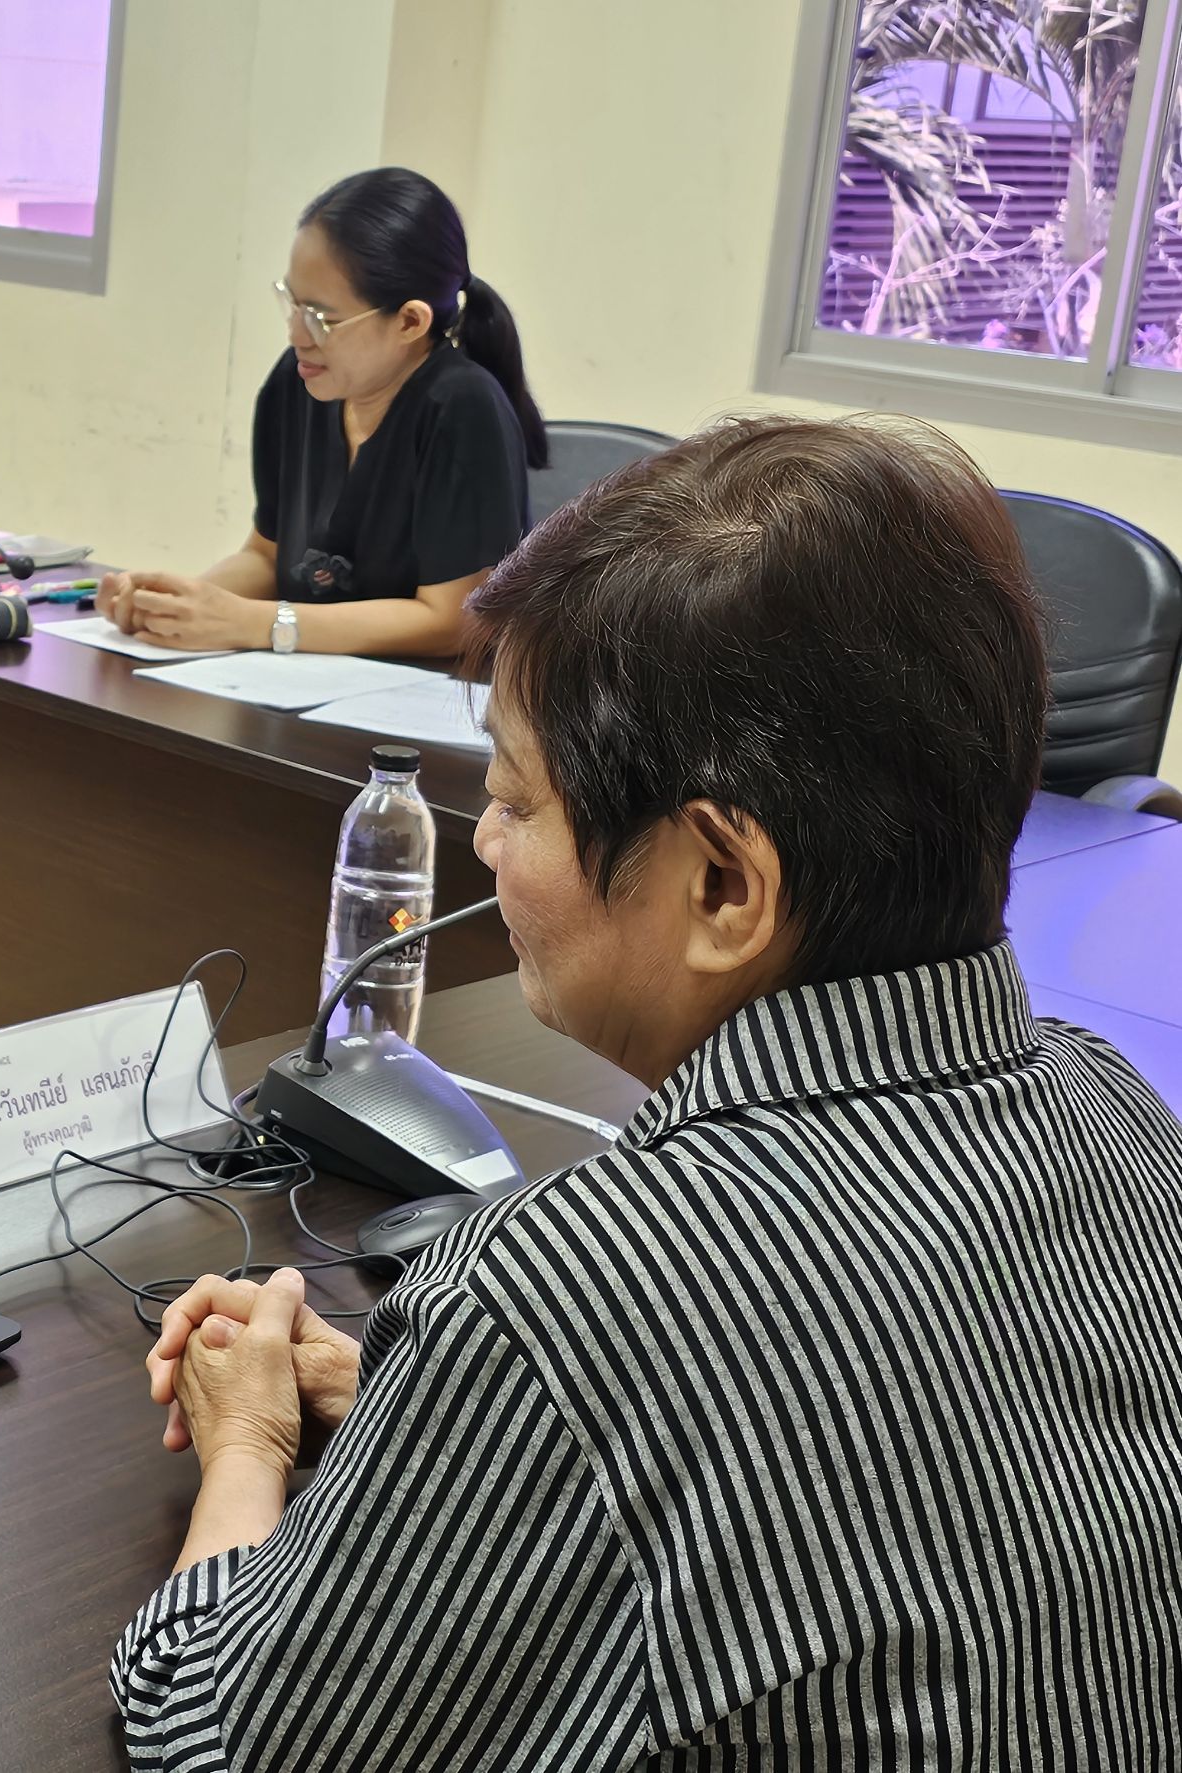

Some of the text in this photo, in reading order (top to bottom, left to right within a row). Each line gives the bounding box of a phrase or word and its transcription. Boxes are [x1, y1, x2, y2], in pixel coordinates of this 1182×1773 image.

[23, 1114, 93, 1157] ผู้ทรงคุณวุฒิ
